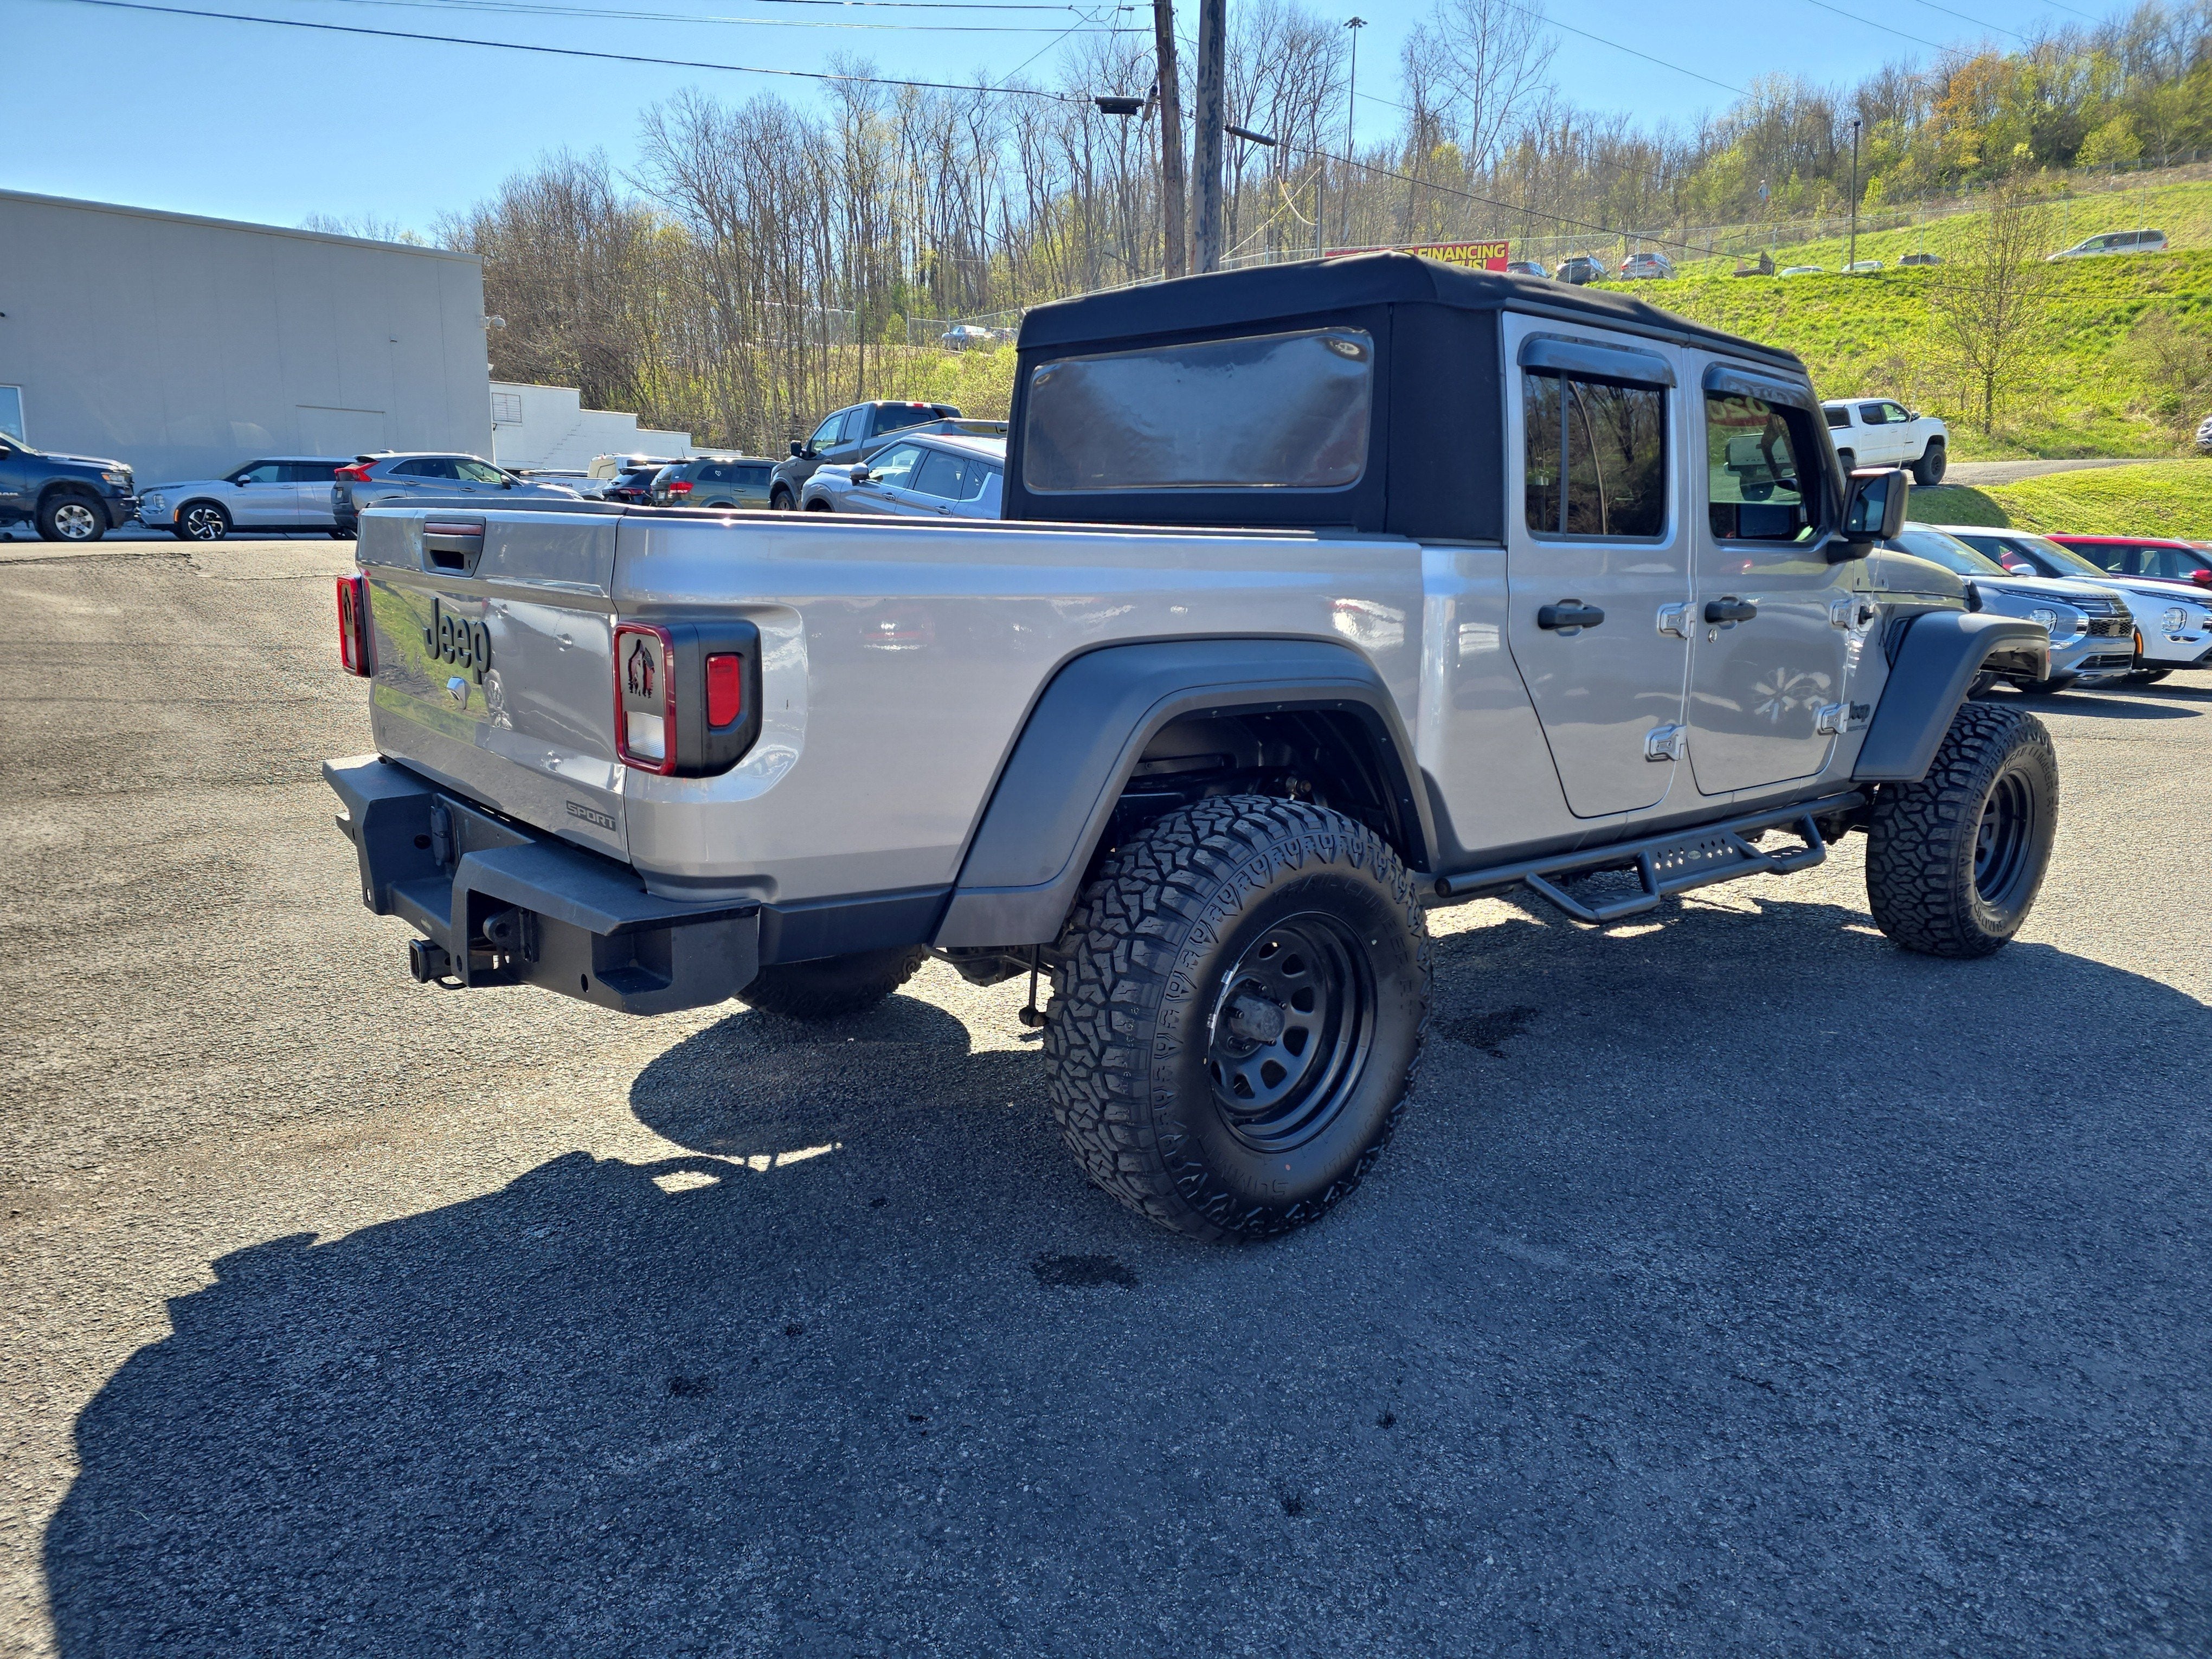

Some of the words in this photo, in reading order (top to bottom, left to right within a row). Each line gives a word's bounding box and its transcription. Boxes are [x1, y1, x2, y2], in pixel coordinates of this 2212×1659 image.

[1418, 243, 1506, 262] FINANCING
[422, 597, 491, 685] Jeep
[1848, 700, 1871, 723] Jeep
[567, 802, 615, 828] SPORT
